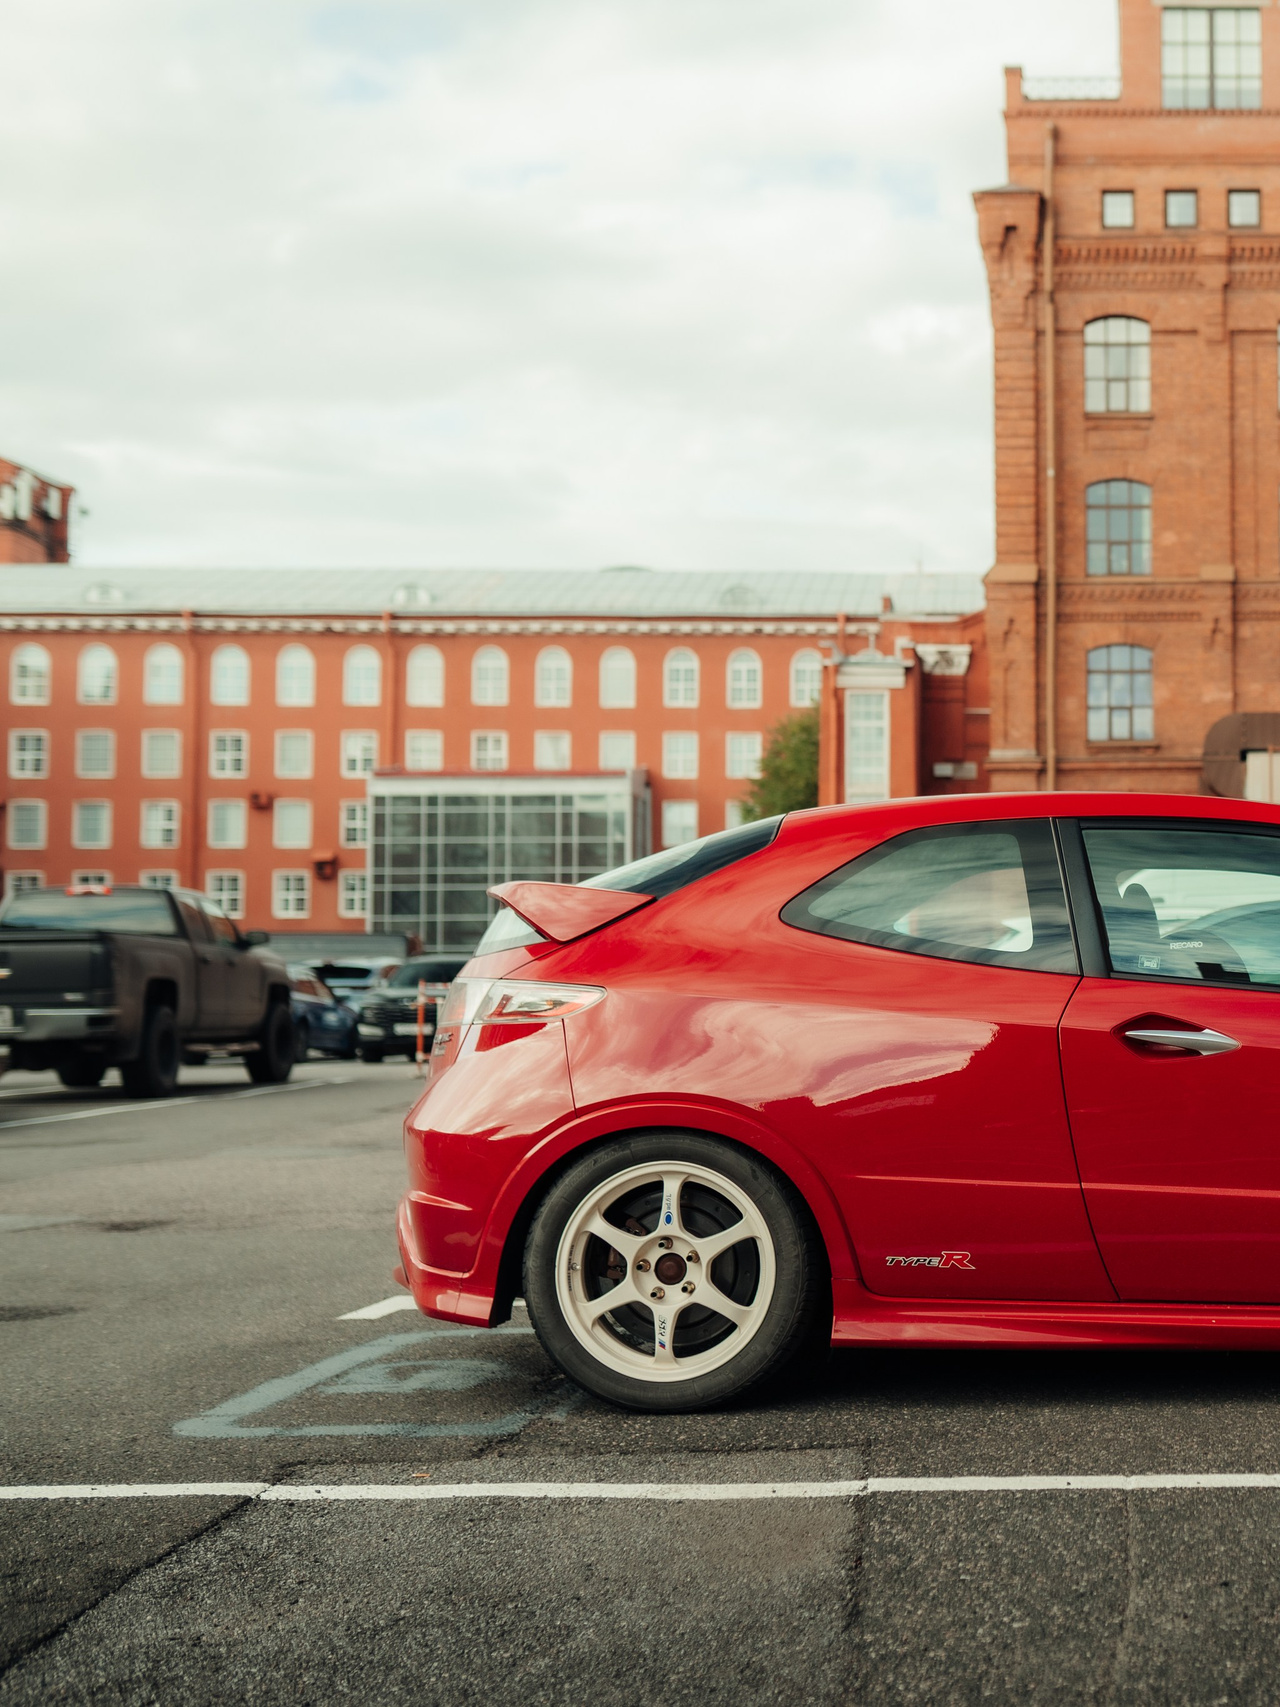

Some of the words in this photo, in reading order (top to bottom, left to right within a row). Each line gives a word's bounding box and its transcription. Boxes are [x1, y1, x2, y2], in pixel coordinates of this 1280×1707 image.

[1170, 941, 1203, 950] RECARO
[885, 1256, 942, 1267] TYPE
[939, 1250, 977, 1270] R
